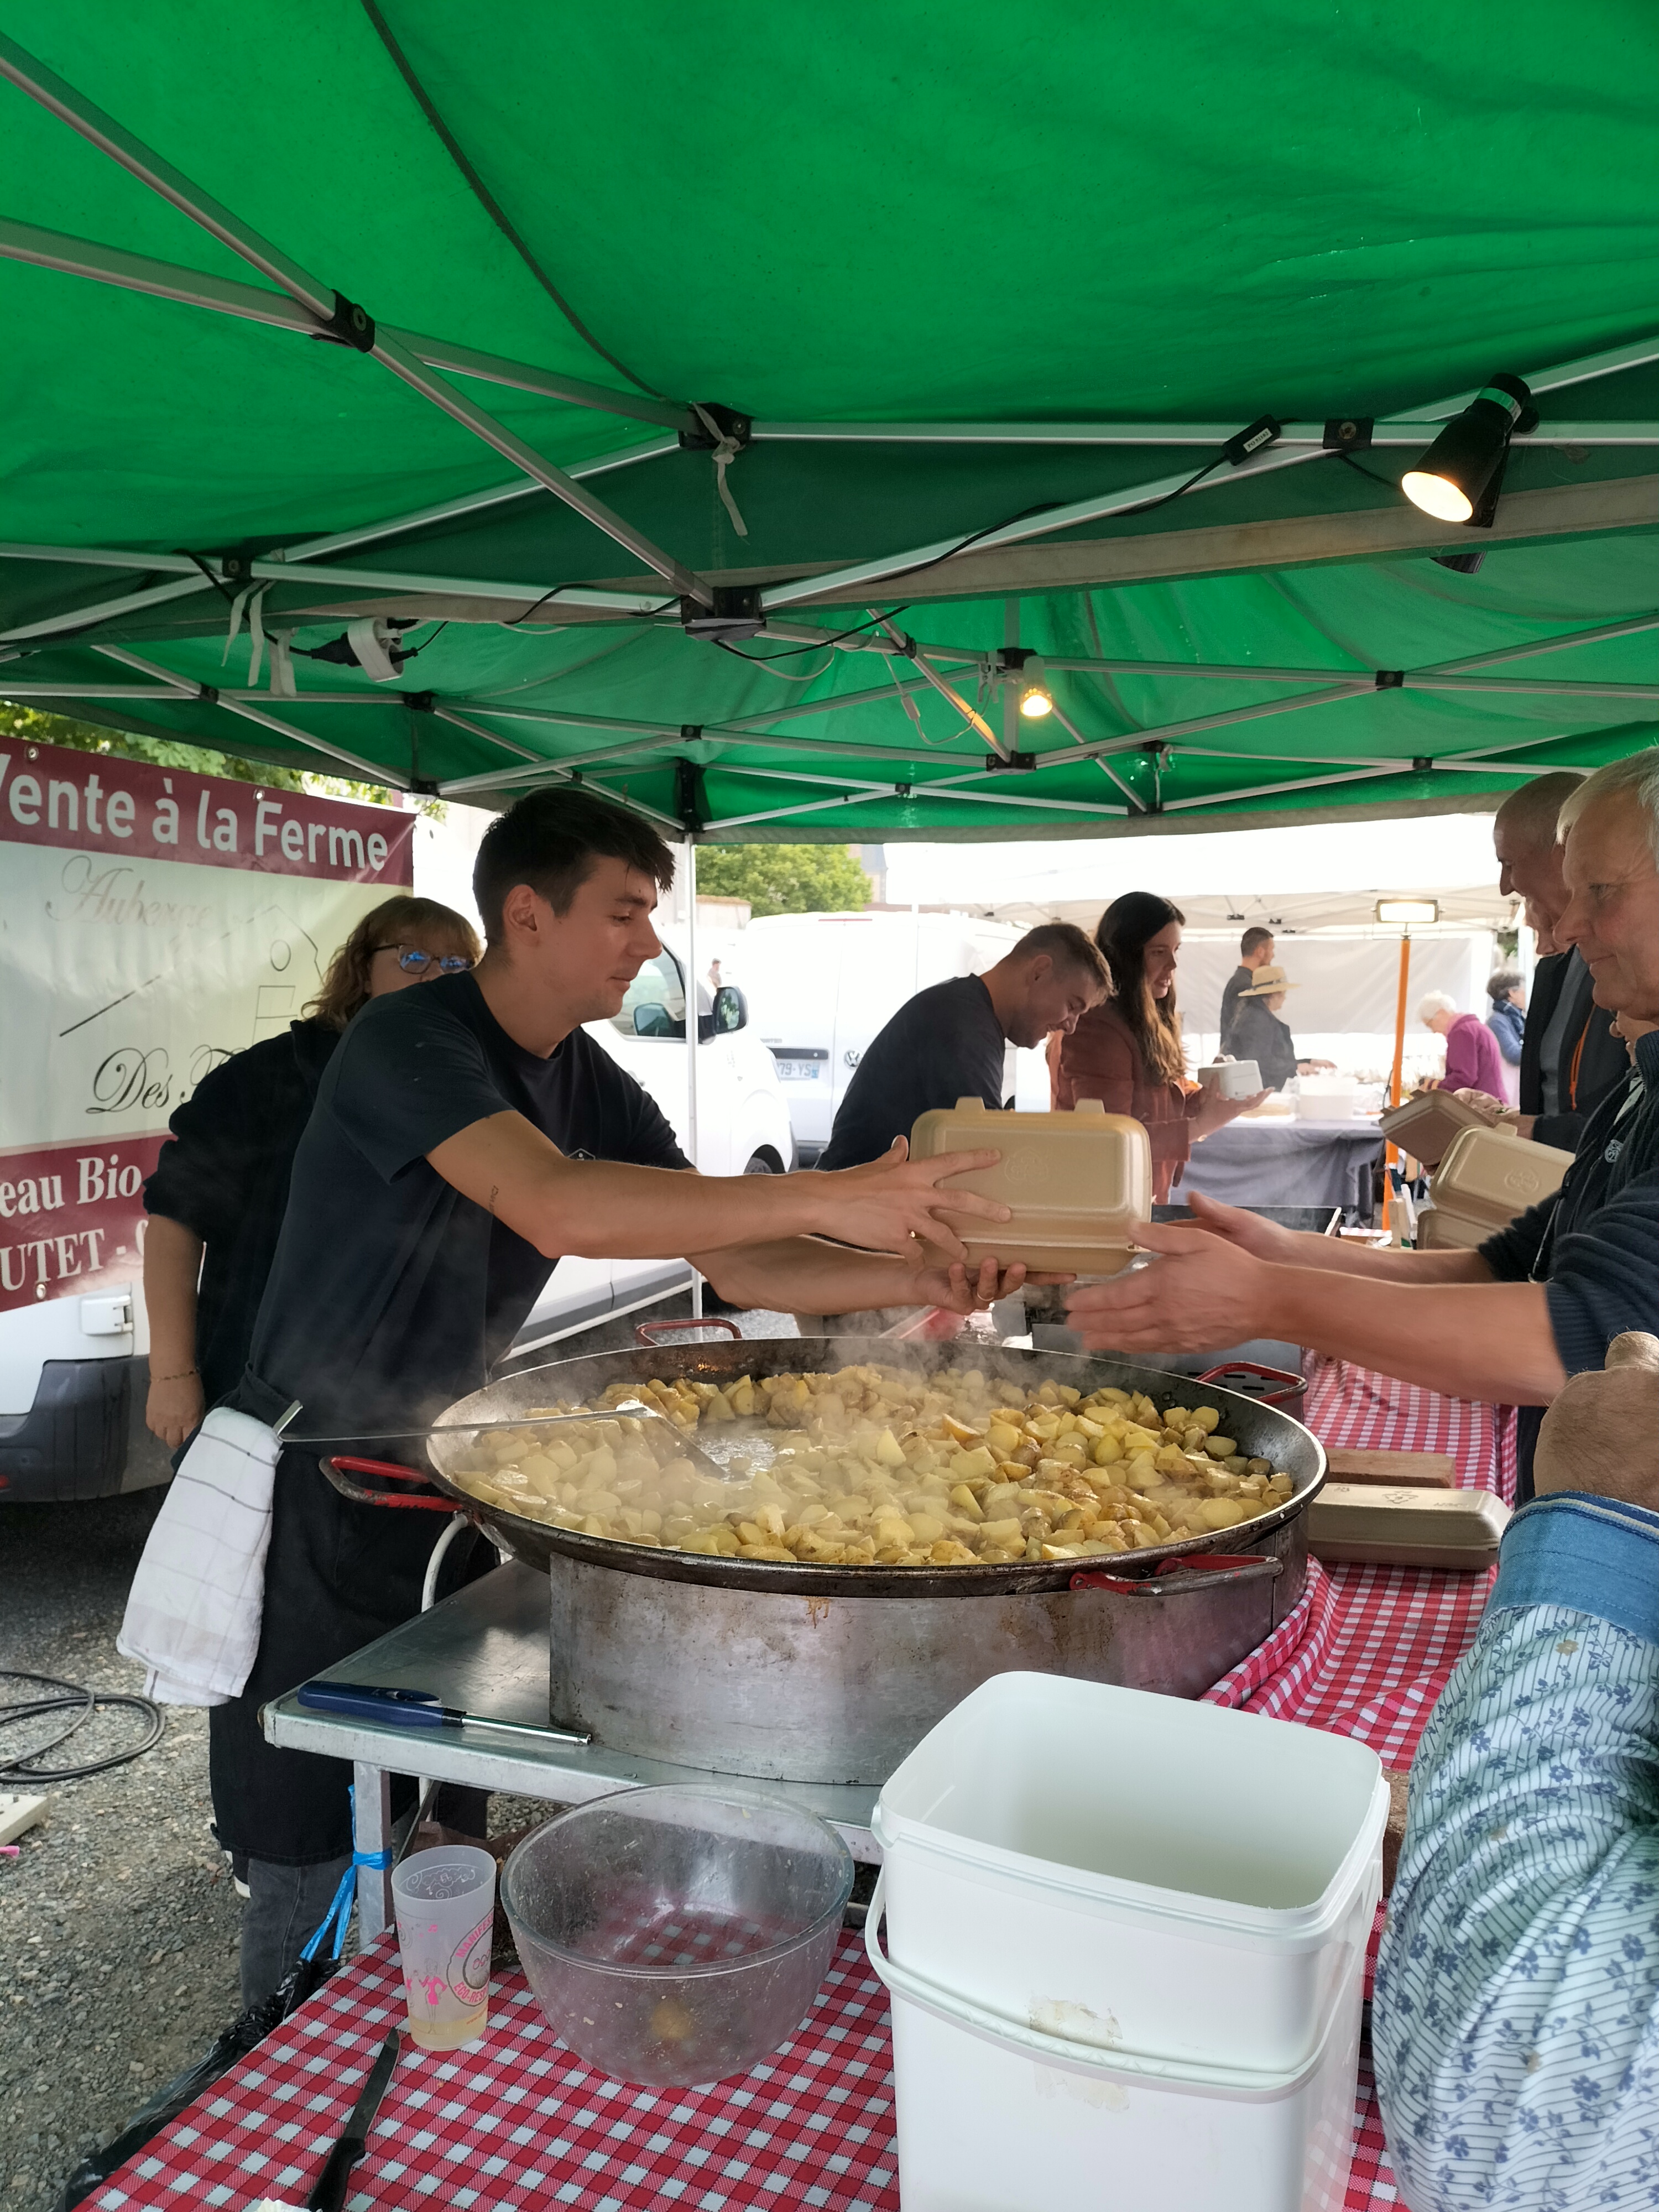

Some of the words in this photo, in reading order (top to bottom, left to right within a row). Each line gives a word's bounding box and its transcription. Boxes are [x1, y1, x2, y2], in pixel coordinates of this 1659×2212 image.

[152, 778, 179, 844] à
[197, 790, 237, 852] la
[255, 800, 388, 871] Ferme
[86, 1047, 173, 1114] Des
[76, 1154, 142, 1204] Bio
[0, 1228, 105, 1291] UTET
